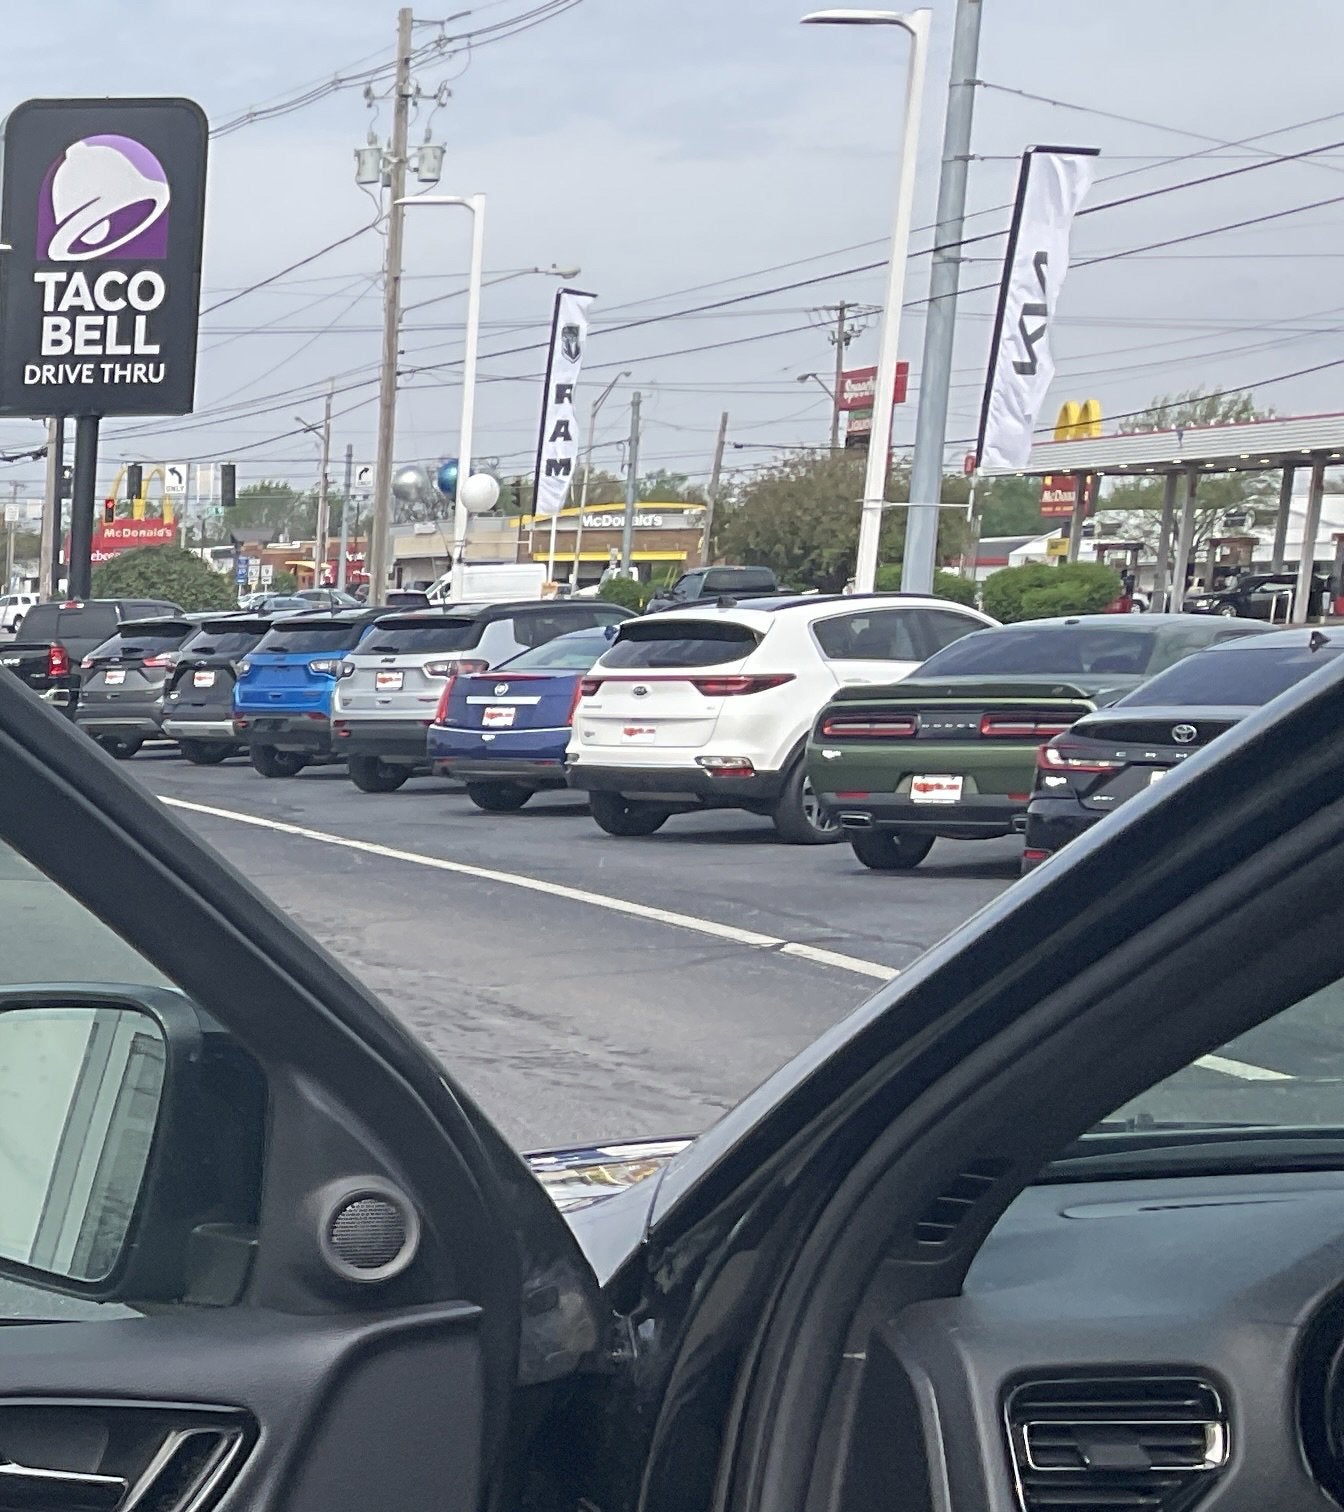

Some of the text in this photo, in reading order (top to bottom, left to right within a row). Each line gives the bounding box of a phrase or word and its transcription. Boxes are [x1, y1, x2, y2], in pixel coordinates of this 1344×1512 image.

[34, 271, 165, 312] TACO
[41, 315, 160, 356] BELL
[24, 363, 165, 385] DRIVE THRU
[546, 384, 573, 477] RAM
[103, 528, 173, 538] McDonald's
